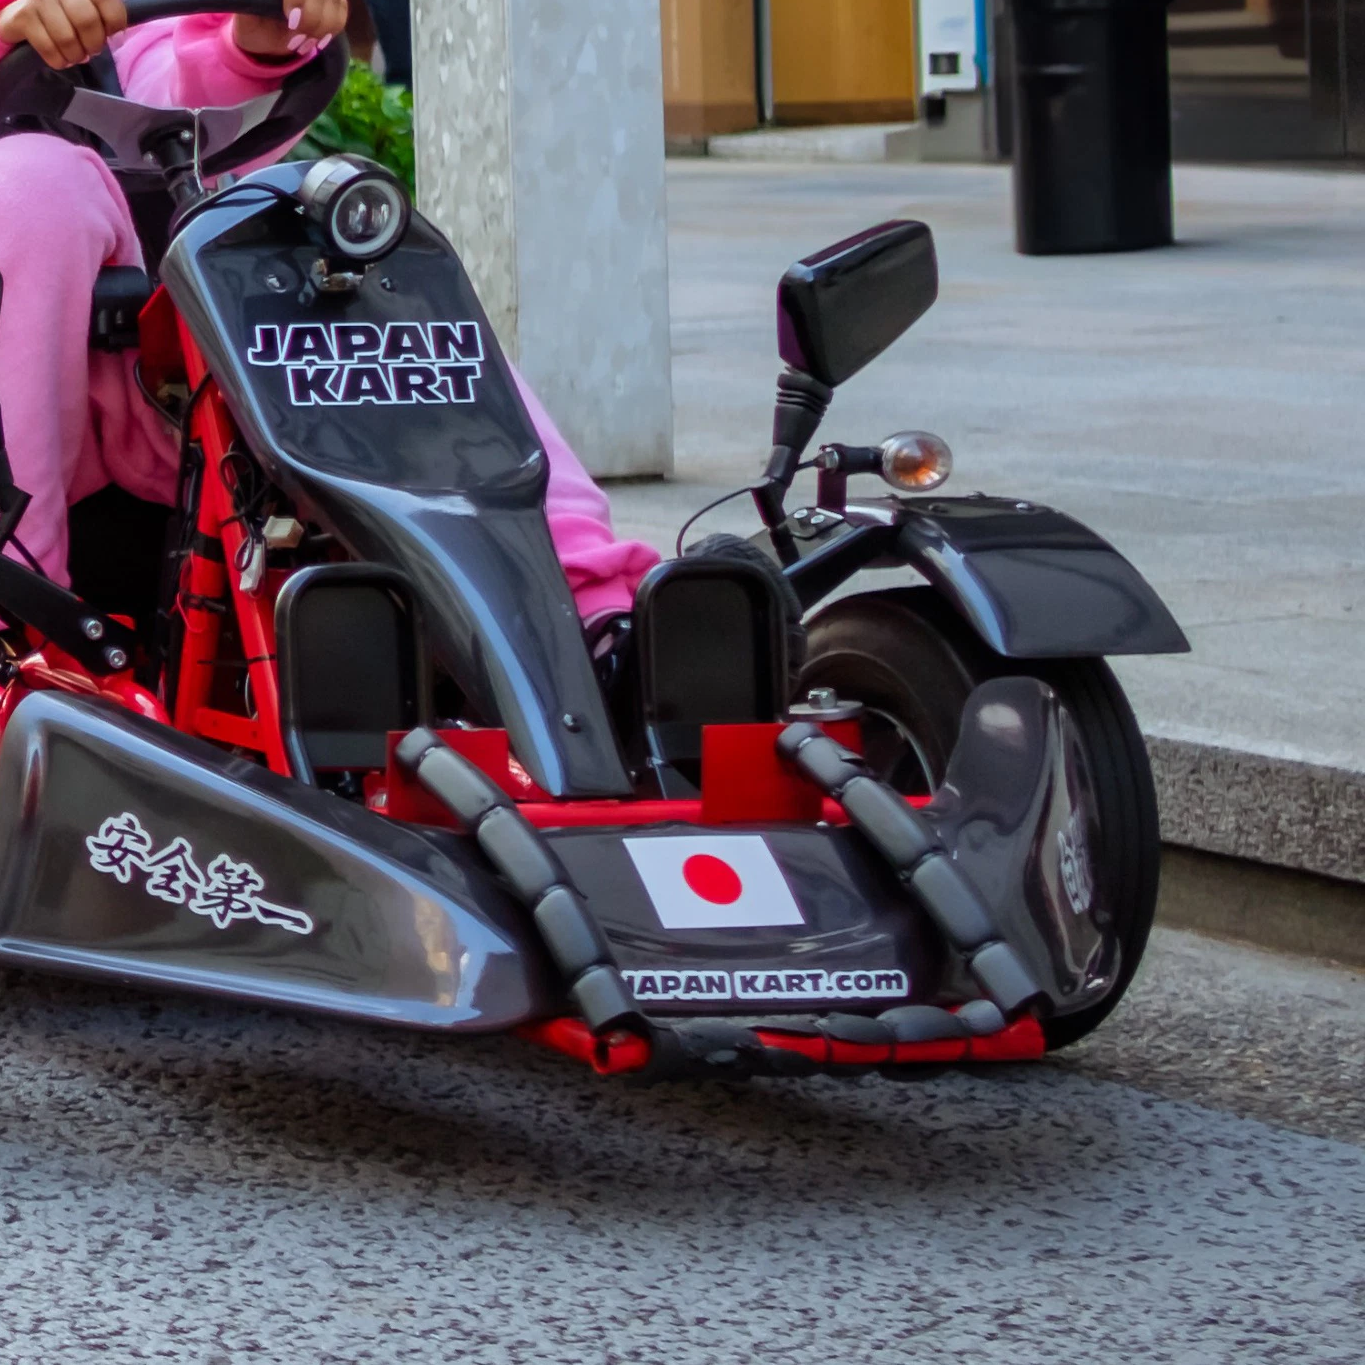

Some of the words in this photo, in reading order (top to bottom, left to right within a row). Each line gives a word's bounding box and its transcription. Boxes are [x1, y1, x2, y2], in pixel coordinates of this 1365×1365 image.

[248, 322, 485, 366] JAPAN
[286, 363, 482, 406] KART
[86, 812, 313, 935] 安全第一
[733, 969, 907, 999] KART.com
